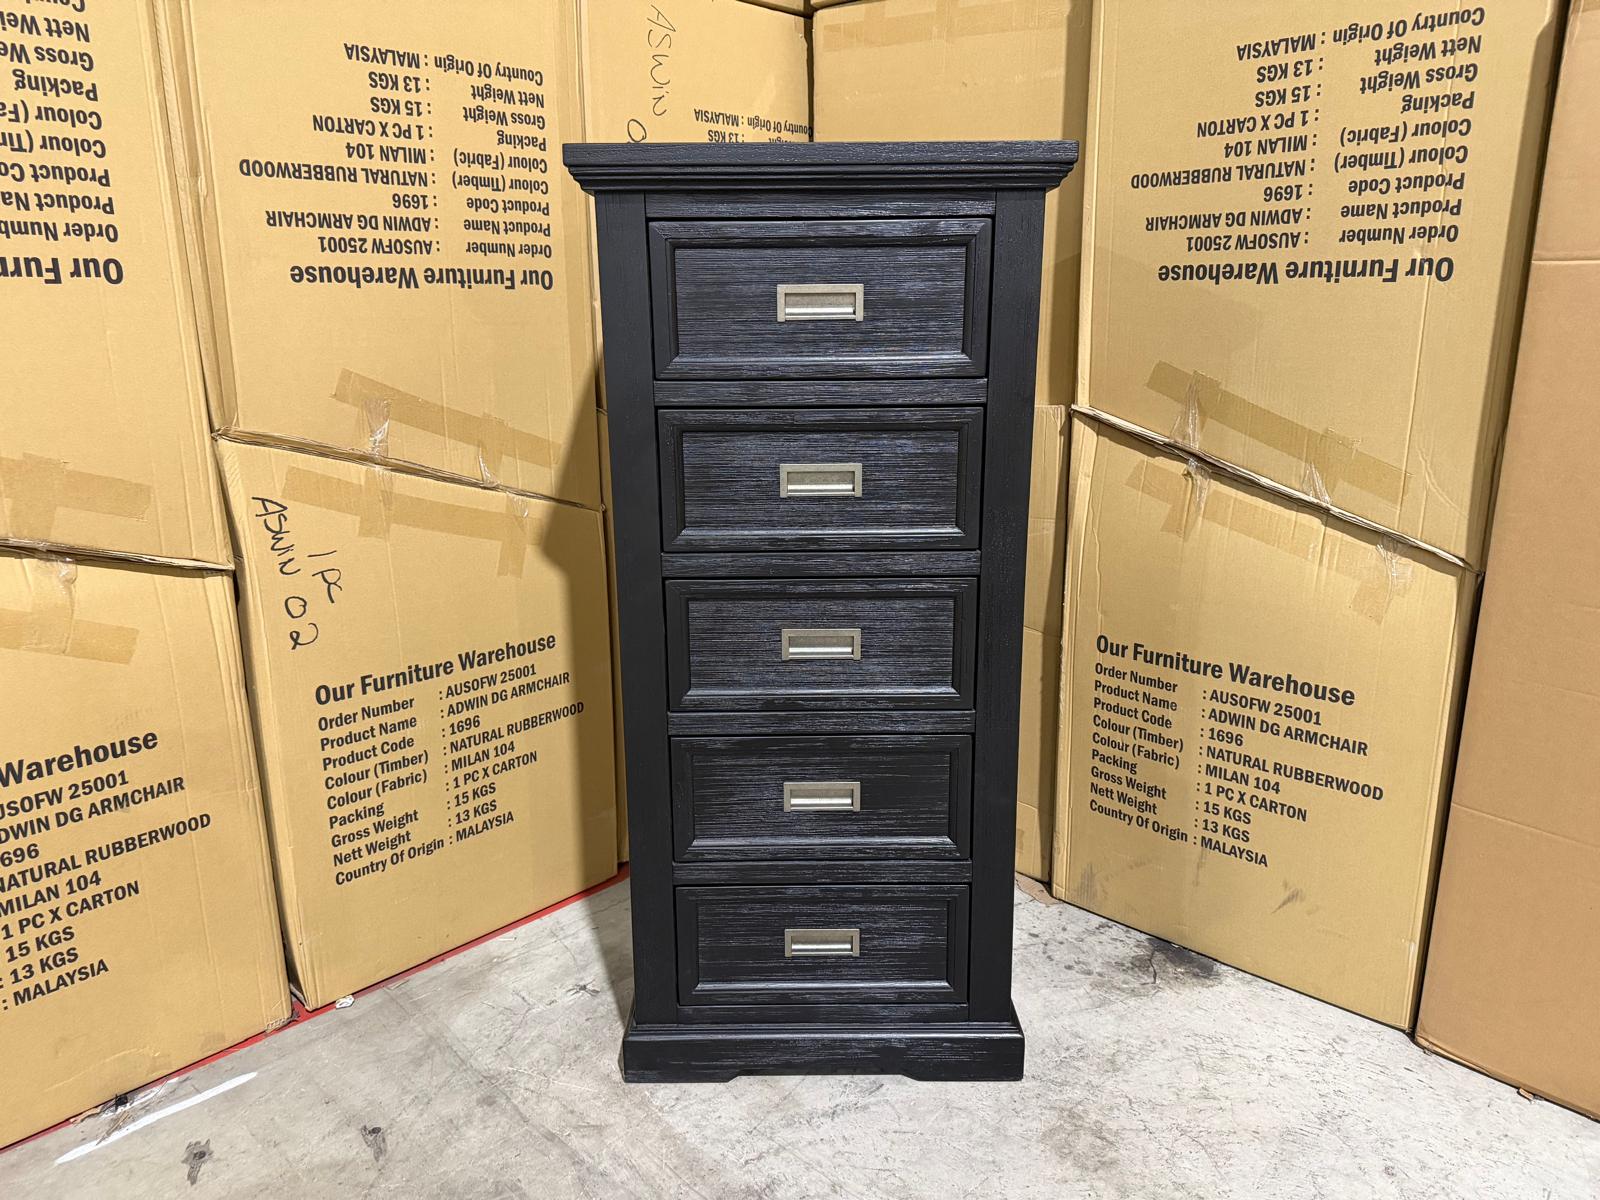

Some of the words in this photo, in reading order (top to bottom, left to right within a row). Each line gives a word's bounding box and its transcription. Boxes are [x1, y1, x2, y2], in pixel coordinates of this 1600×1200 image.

[44, 18, 90, 43] Nett
[1387, 20, 1407, 39] Of
[1412, 7, 1485, 32] Country
[1333, 23, 1383, 45] Origin
[344, 43, 420, 69] MALAYSIA
[1237, 33, 1316, 60] MALAYSIA
[34, 46, 93, 71] Gross
[434, 55, 474, 76] Origin
[368, 72, 399, 91] KGS
[478, 63, 492, 78] Of
[495, 62, 543, 86] Country
[1426, 63, 1478, 83] Gross
[12, 69, 98, 101] Packing
[403, 76, 421, 93] 13
[1360, 71, 1420, 94] Weight
[471, 84, 515, 105] Weight
[518, 91, 544, 108] Nett
[1255, 88, 1286, 107] KGS
[1291, 85, 1311, 103] 15
[1401, 91, 1475, 114] Packing
[35, 106, 102, 130] Colour
[694, 108, 740, 127] MALAYSIA
[747, 116, 772, 132] Origin
[773, 121, 782, 134] Of
[1197, 117, 1256, 137] CARTON
[1261, 115, 1271, 131] X
[1274, 112, 1295, 129] PC
[1301, 110, 1309, 126] 1
[40, 136, 106, 158] Colour
[707, 129, 726, 143] KGS
[346, 142, 374, 160] 104
[380, 145, 426, 164] MILAN
[454, 148, 504, 170] (Fabric)
[1335, 147, 1404, 173] (Timber)
[1409, 145, 1468, 165] Colour
[0, 162, 25, 182] Co
[29, 164, 110, 187] Product
[508, 156, 547, 173] Colour
[1236, 160, 1305, 180] NATURAL
[1131, 167, 1232, 189] RUBBERWOOD
[1, 191, 30, 211] Na
[34, 193, 114, 215] Product
[392, 193, 428, 209] 1696
[467, 198, 499, 213] Code
[502, 200, 549, 216] Product
[265, 211, 353, 229] ARMCHAIR
[357, 215, 378, 230] DG
[383, 216, 431, 232] ADWIN
[464, 219, 500, 235] Name
[503, 221, 550, 237] Product
[63, 223, 118, 242] Order
[1186, 235, 1232, 252] 25001
[1235, 232, 1301, 250] AUSOFW
[1339, 227, 1405, 245] Number
[1409, 225, 1458, 243] Order
[318, 237, 367, 253] 25001
[372, 238, 432, 255] AUSOFW
[466, 242, 515, 257] Number
[518, 244, 552, 258] Order
[70, 258, 123, 284] Our
[290, 266, 419, 289] Warehouse
[424, 268, 515, 289] Furniture
[520, 270, 553, 290] Our
[1158, 262, 1278, 285] Warehouse
[1286, 259, 1399, 283] Furniture
[1405, 257, 1453, 282] Our
[315, 684, 355, 706] Our
[361, 661, 454, 695] Furniture
[458, 635, 555, 671] Warehouse
[1096, 635, 1128, 658] Our
[1133, 643, 1223, 679] Furniture
[1229, 663, 1355, 705] Warehouse
[318, 712, 358, 731] Order
[361, 698, 414, 720] Number
[446, 674, 497, 698] AUSOFW
[500, 664, 536, 684] 25001
[321, 726, 376, 751] Product
[379, 717, 416, 736] Name
[447, 694, 488, 717] ADWIN
[491, 689, 508, 704] DG
[511, 672, 569, 699] ARMCHAIR
[1094, 697, 1138, 719] Product
[1142, 710, 1172, 729] Code
[1209, 728, 1243, 746] 1696
[1095, 680, 1139, 702] Product
[1143, 692, 1177, 711] Name
[1208, 708, 1255, 730] ADWIN
[1260, 719, 1280, 736] DG
[1283, 726, 1368, 756] ARMCHAIR
[325, 769, 370, 789] Colour
[374, 750, 428, 778] (Timber)
[450, 727, 504, 753] NATURAL
[507, 702, 584, 736] RUBBERWOOD
[0, 733, 158, 787] Warehouse
[1093, 715, 1130, 735] Colour
[1133, 726, 1183, 753] (Timber)
[1207, 746, 1269, 772] NATURAL
[1273, 762, 1383, 800] RUBBERWOOD
[1093, 732, 1129, 752] Colour
[1132, 744, 1179, 770] (Fabric)
[1206, 764, 1249, 786] MILAN
[1254, 777, 1280, 794] 104
[68, 770, 128, 800] 25001
[329, 803, 384, 829] Packing
[453, 777, 460, 789] 1
[464, 770, 479, 785] PC
[482, 766, 489, 779] X
[492, 751, 537, 775] CARTON
[1091, 766, 1122, 785] Gross
[1125, 776, 1166, 800] Weight
[1204, 801, 1219, 815] 15
[1224, 806, 1251, 824] KGS
[55, 807, 83, 827] DG
[88, 777, 185, 818] ARMCHAIR
[85, 814, 210, 865] RUBBERWOOD
[1090, 799, 1133, 826] Country
[1136, 815, 1149, 829] Of
[1152, 821, 1187, 842] Origin
[1201, 836, 1267, 867] MALAYSIA
[0, 843, 39, 867] 696
[336, 859, 387, 885] Country
[391, 850, 404, 865] Of
[408, 839, 444, 859] Origin
[456, 811, 514, 842] MALAYSIA
[0, 884, 59, 917] MILAN
[66, 870, 101, 895] 104
[1, 924, 13, 940] 1
[18, 913, 45, 934] PC
[48, 907, 62, 924] X
[66, 880, 139, 917] CARTON
[6, 941, 30, 963] 15
[35, 926, 74, 951] KGS
[10, 964, 34, 984] 13
[40, 947, 78, 973] KGS
[13, 959, 109, 1006] MALAYSIA
